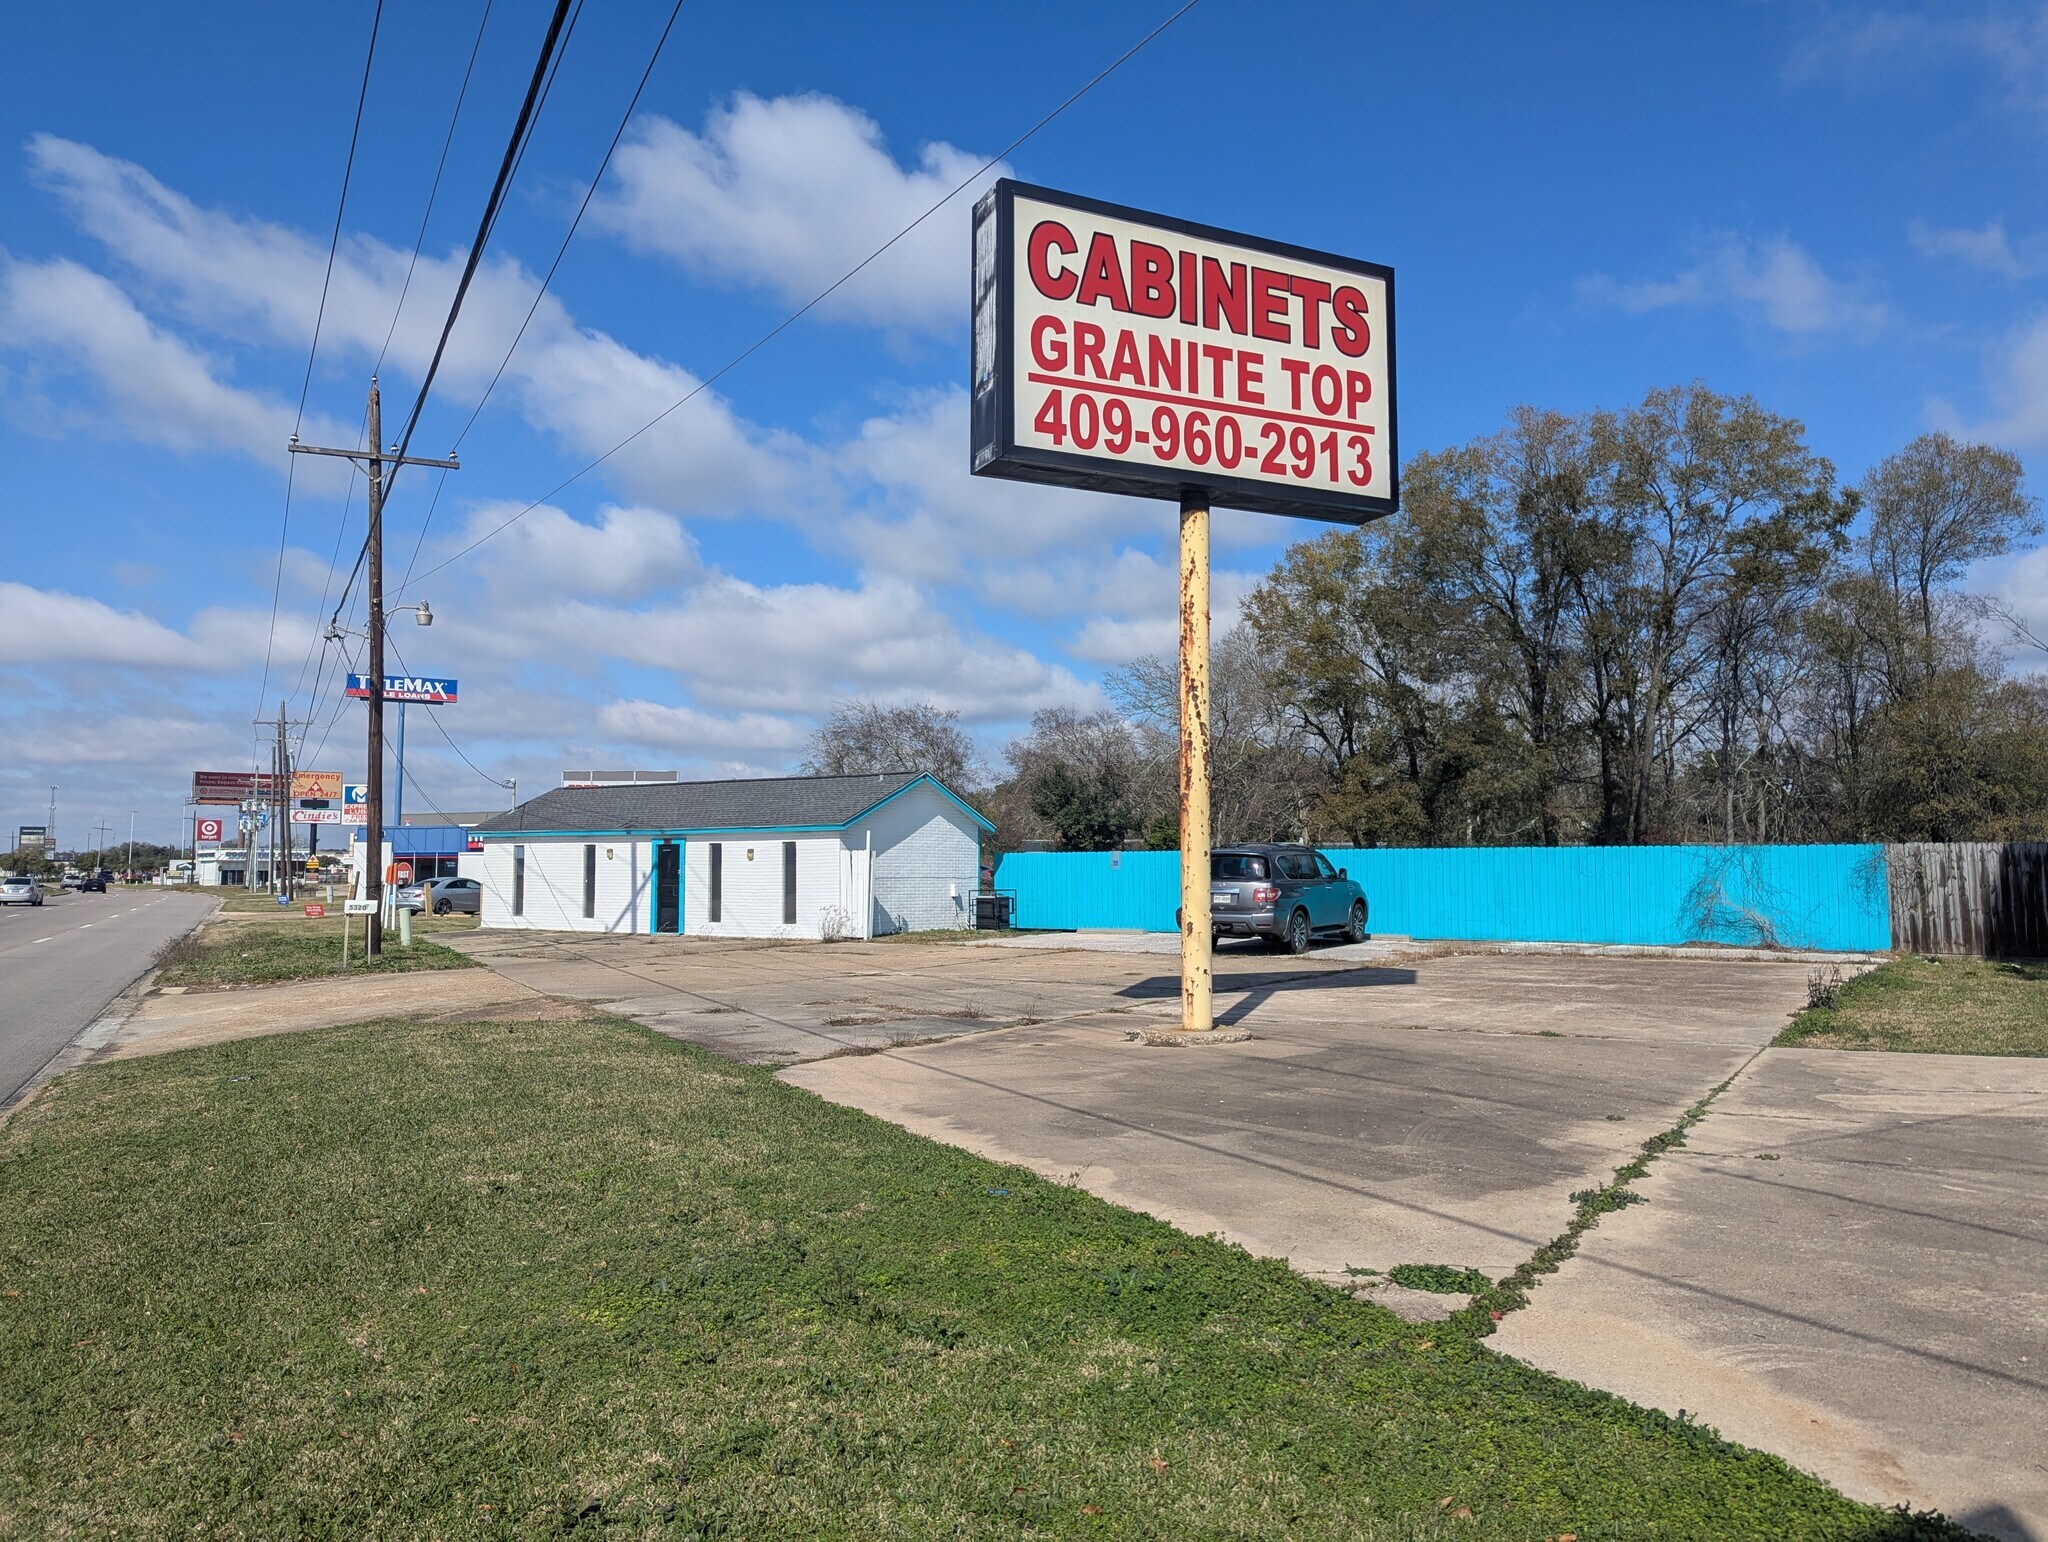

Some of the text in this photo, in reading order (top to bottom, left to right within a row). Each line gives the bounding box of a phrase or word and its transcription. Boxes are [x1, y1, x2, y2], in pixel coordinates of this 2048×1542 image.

[1027, 219, 1371, 358] CABINETS
[1030, 315, 1372, 419] GRANITE TOP
[1033, 389, 1373, 487] 409-960-2913
[356, 675, 447, 699] TLEMAX
[293, 811, 338, 822] Cindie's
